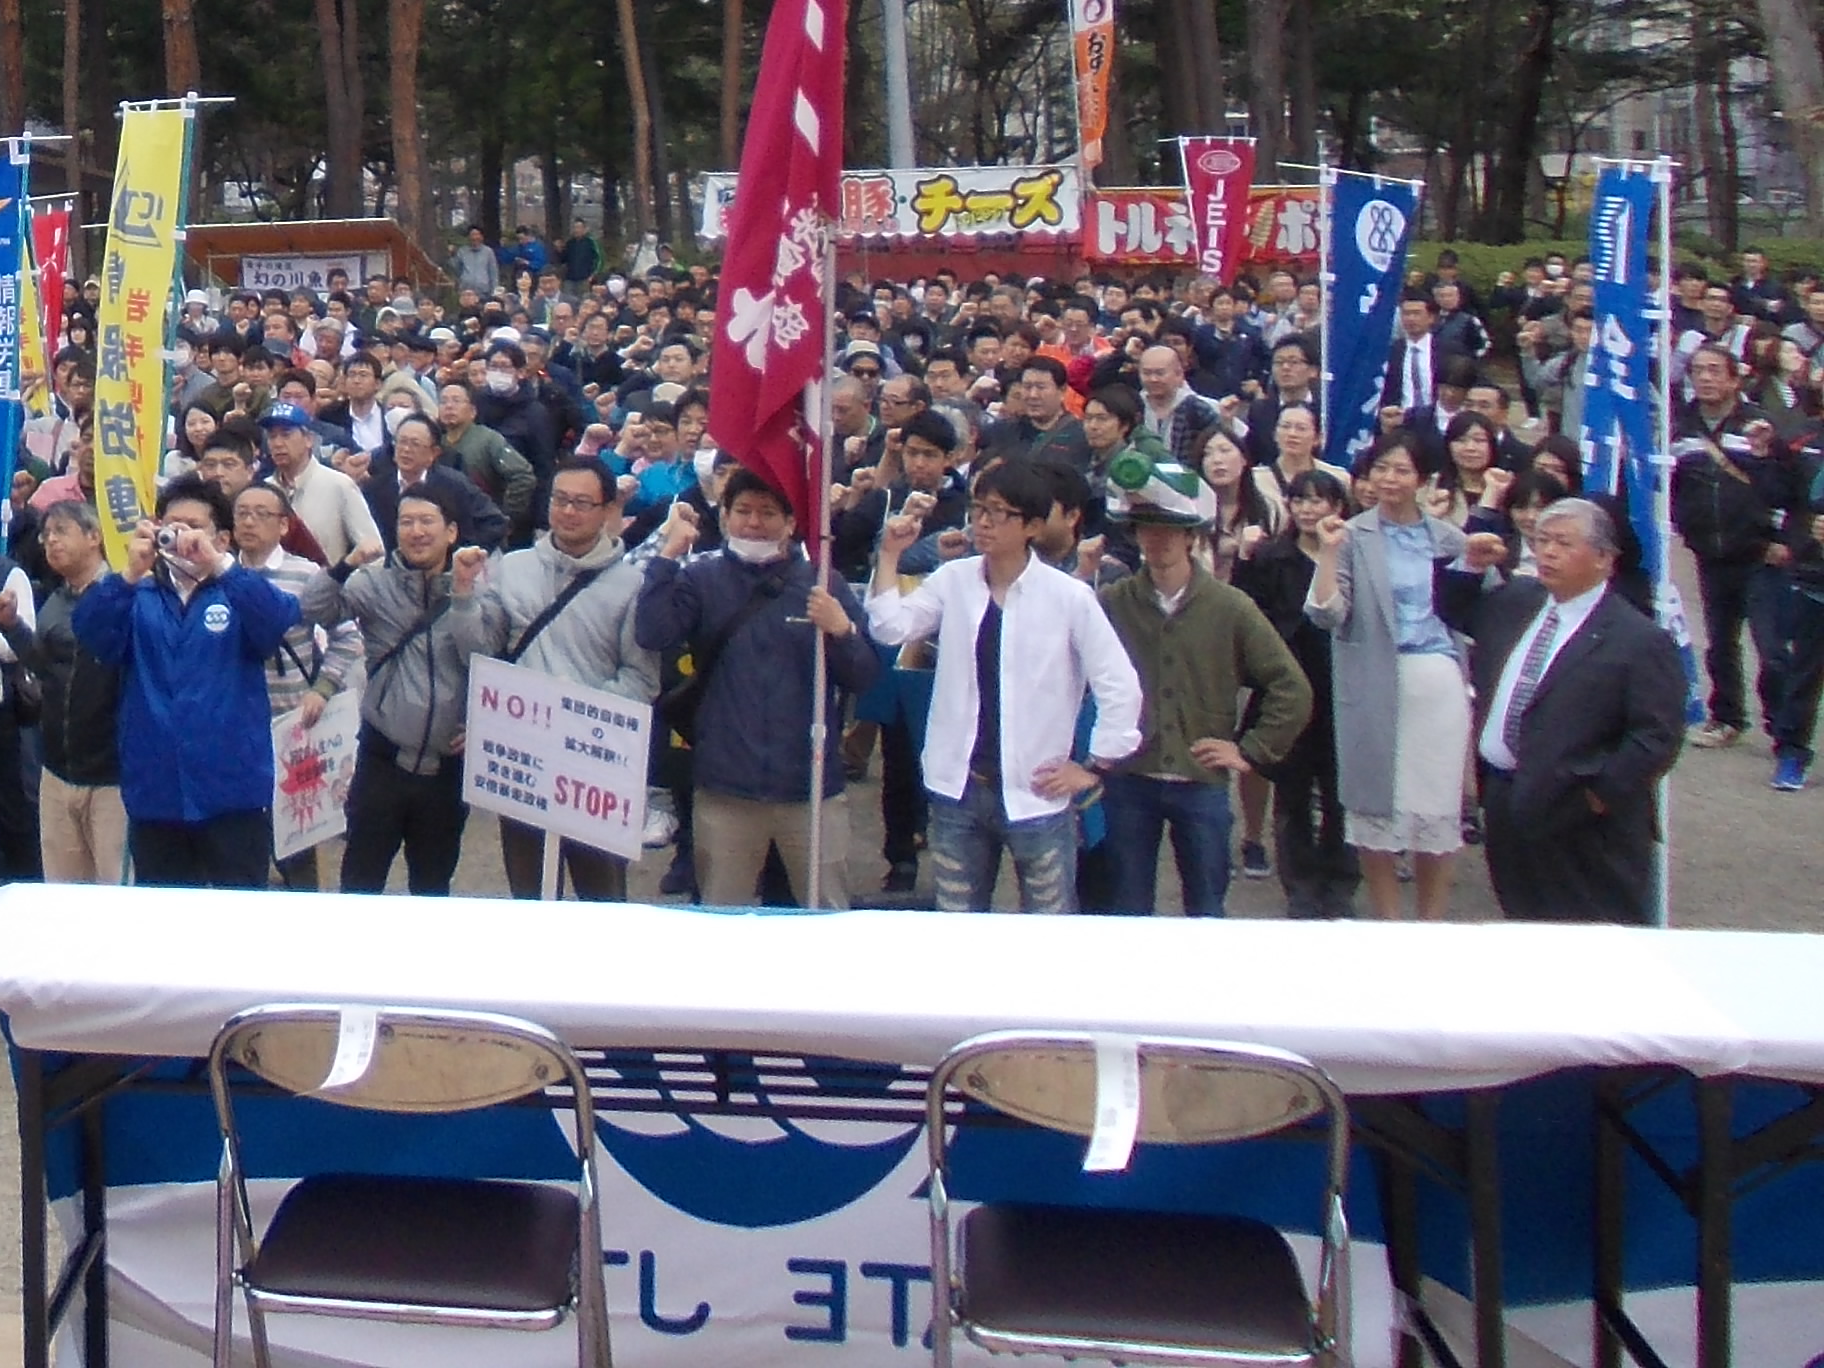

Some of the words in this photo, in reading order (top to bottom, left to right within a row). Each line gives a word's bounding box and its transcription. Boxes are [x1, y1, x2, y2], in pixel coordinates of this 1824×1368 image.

[1201, 179, 1227, 273] JEIS
[253, 270, 323, 288] 幻の川魚
[591, 727, 604, 739] の
